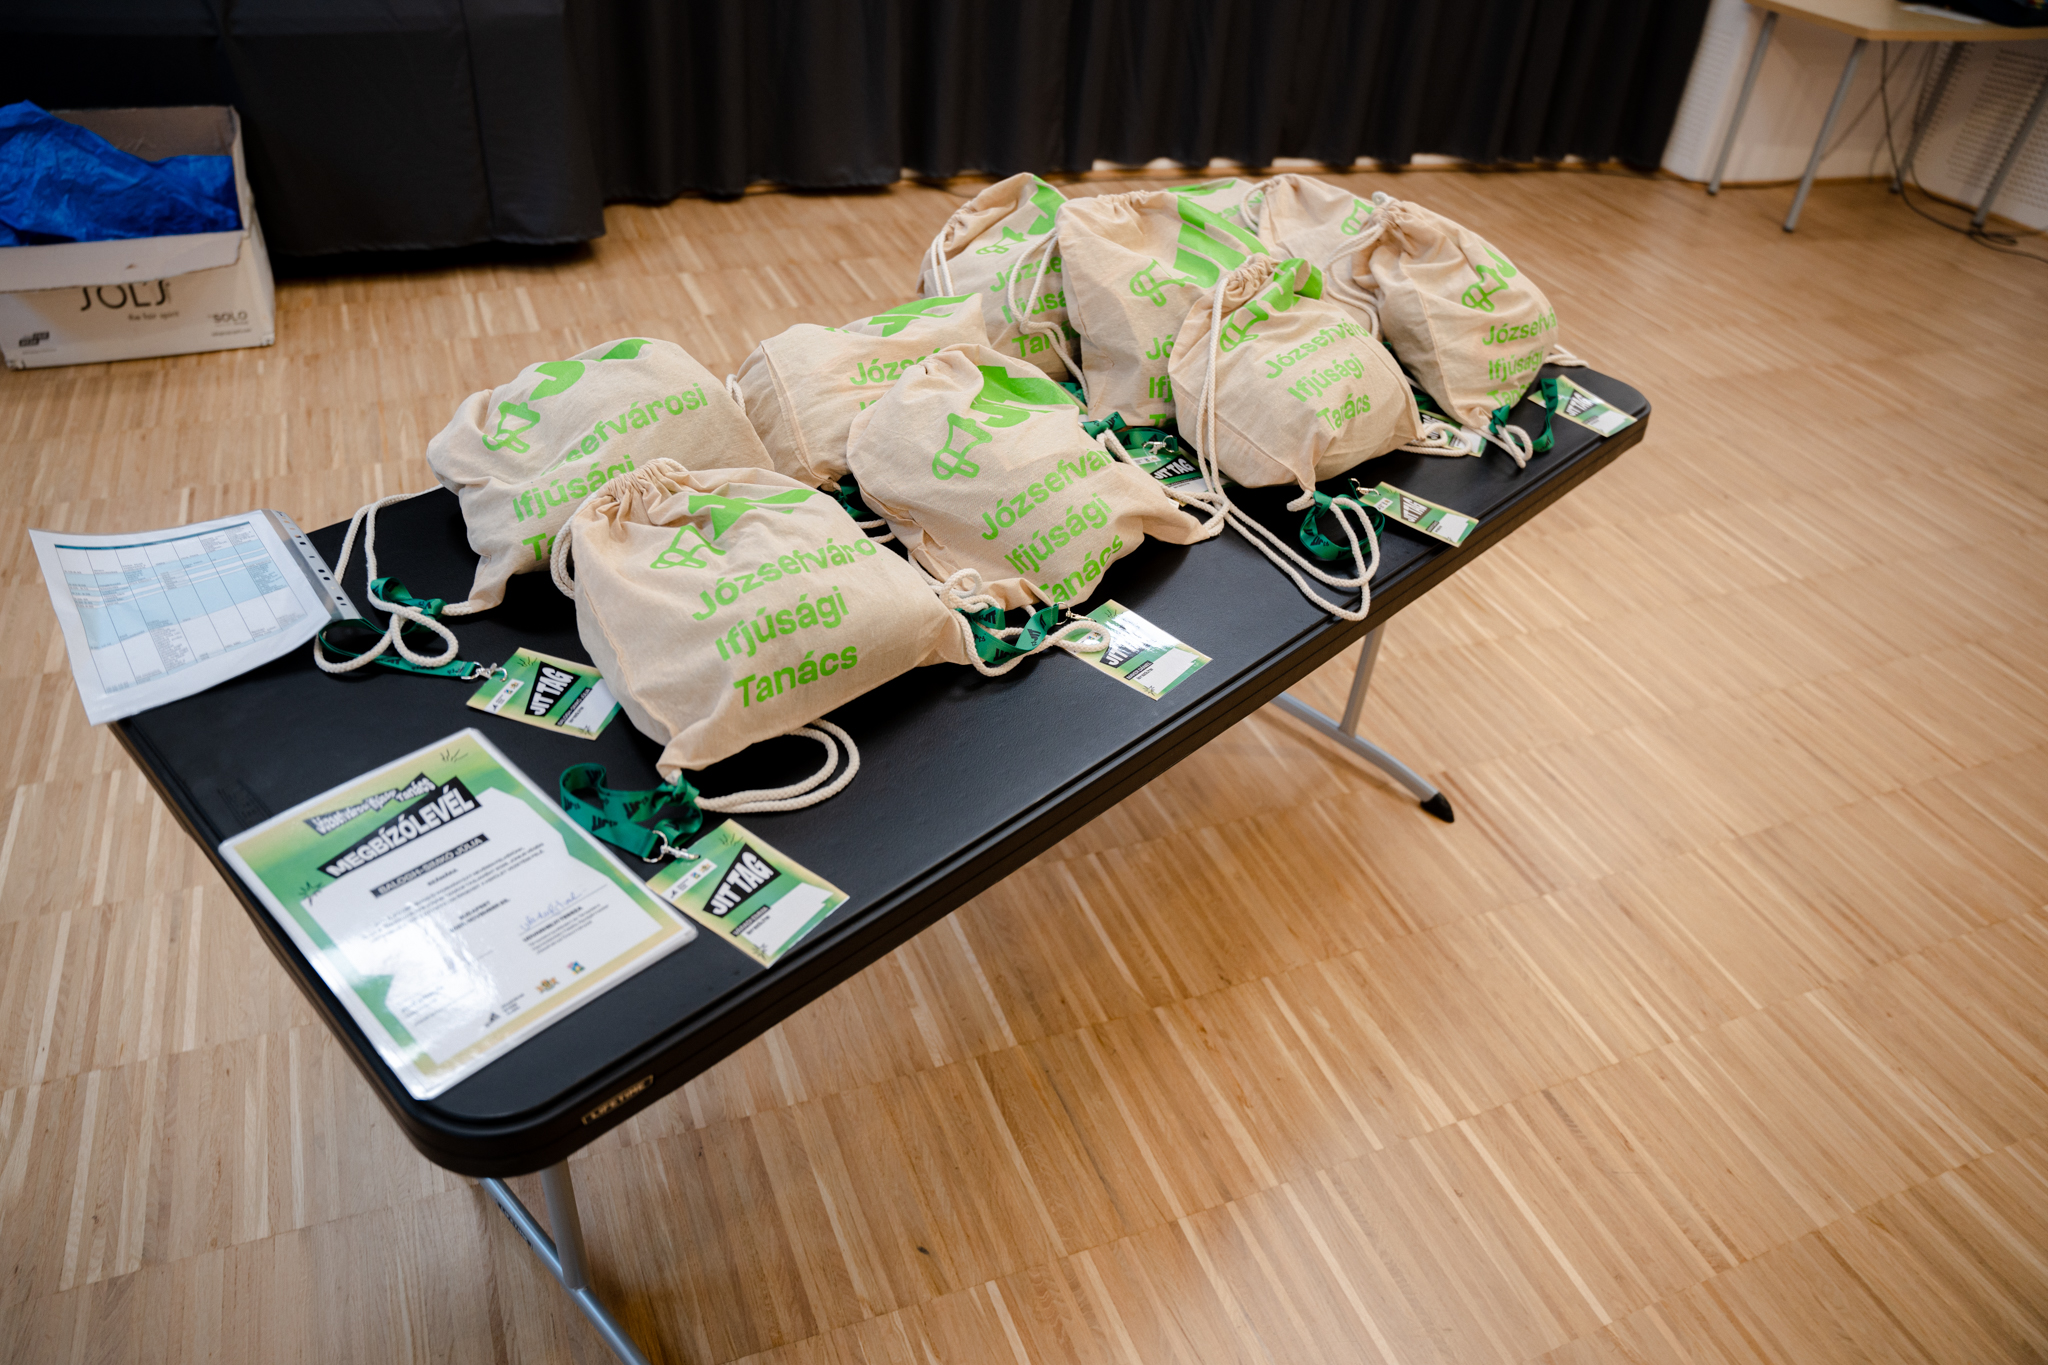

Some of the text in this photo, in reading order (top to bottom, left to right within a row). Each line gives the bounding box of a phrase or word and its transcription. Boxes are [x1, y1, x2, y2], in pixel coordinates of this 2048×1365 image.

[1287, 352, 1366, 403] Ifjúsági
[513, 454, 635, 522] Ifjúsági
[1169, 458, 1196, 475] TAG
[1004, 492, 1113, 575] Ifjúsági
[715, 585, 850, 662] Ifjúsági
[529, 692, 555, 716] JIT
[535, 667, 574, 696] TAG
[733, 645, 858, 708] Tanács
[325, 785, 476, 878] MEGBÍZÓLEVÉL
[712, 881, 742, 916] JIT
[728, 851, 774, 898] TAG
